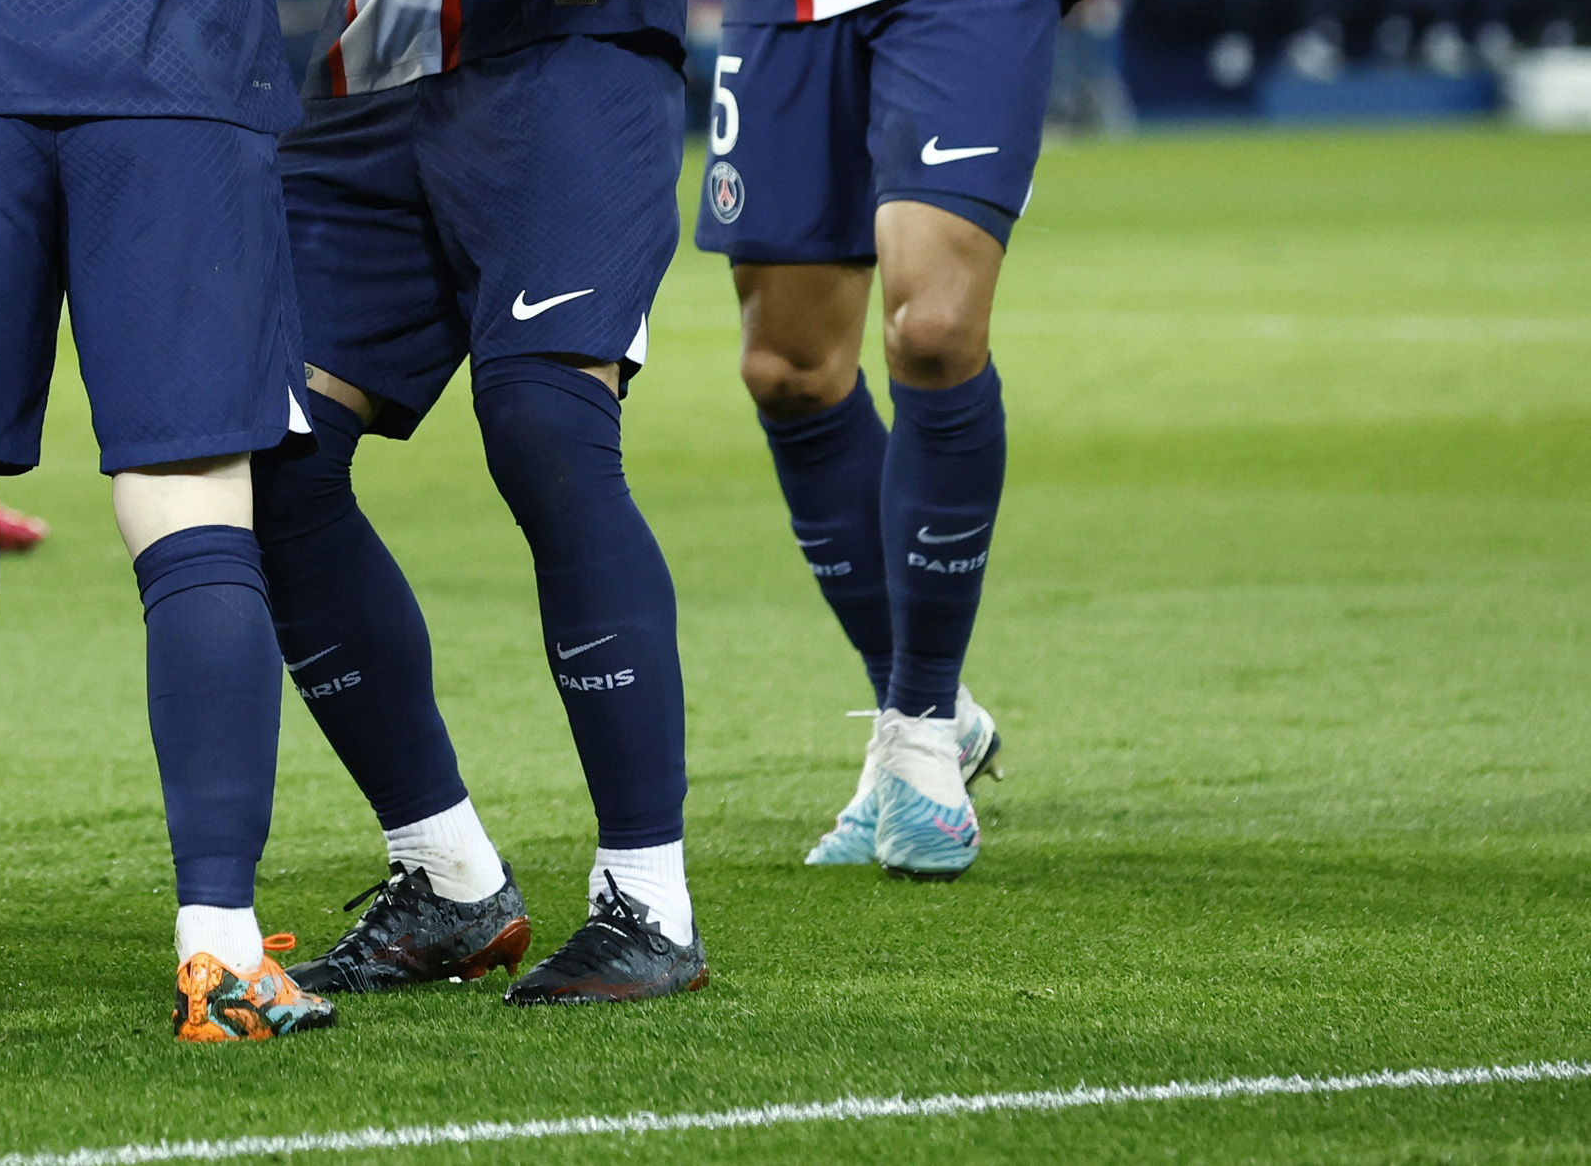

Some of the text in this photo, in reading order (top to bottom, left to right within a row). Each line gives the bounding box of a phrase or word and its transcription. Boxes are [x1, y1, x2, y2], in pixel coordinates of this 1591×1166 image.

[711, 54, 743, 156] 5
[907, 550, 989, 574] PARIS
[558, 668, 635, 692] PARIS
